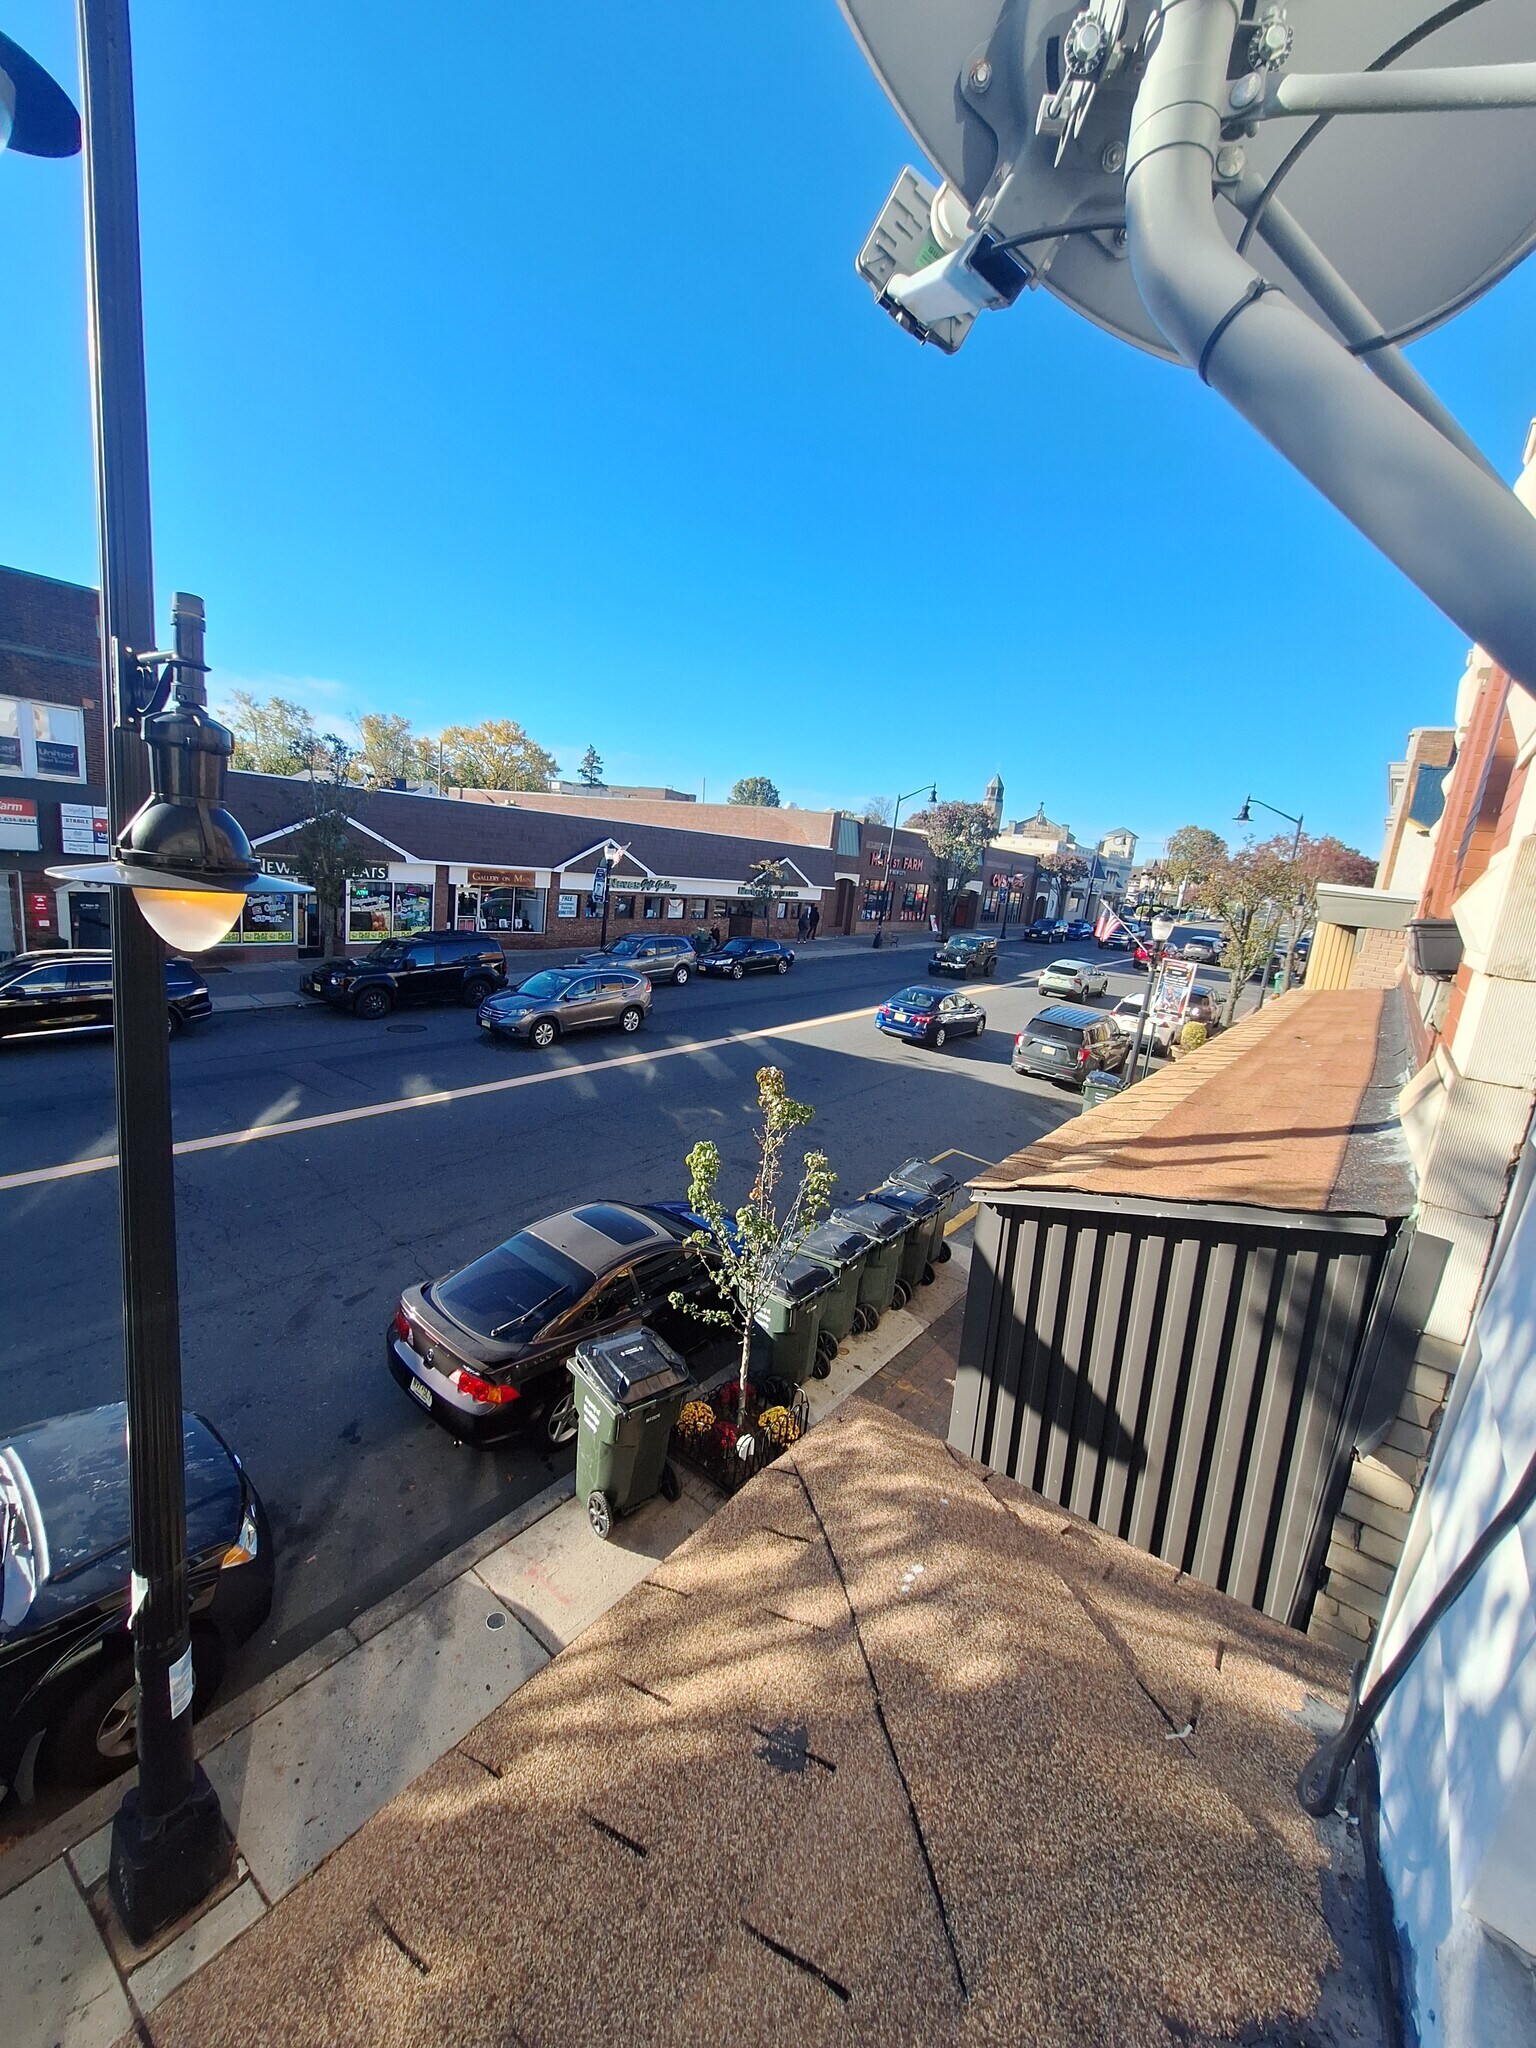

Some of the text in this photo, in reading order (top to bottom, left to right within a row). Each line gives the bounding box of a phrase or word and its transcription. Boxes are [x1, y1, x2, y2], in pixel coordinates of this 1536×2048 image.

[38, 746, 75, 758] United
[903, 857, 924, 871] FARM
[472, 871, 498, 882] GALLERY
[992, 873, 1008, 887] CVS
[655, 879, 678, 892] Gallery
